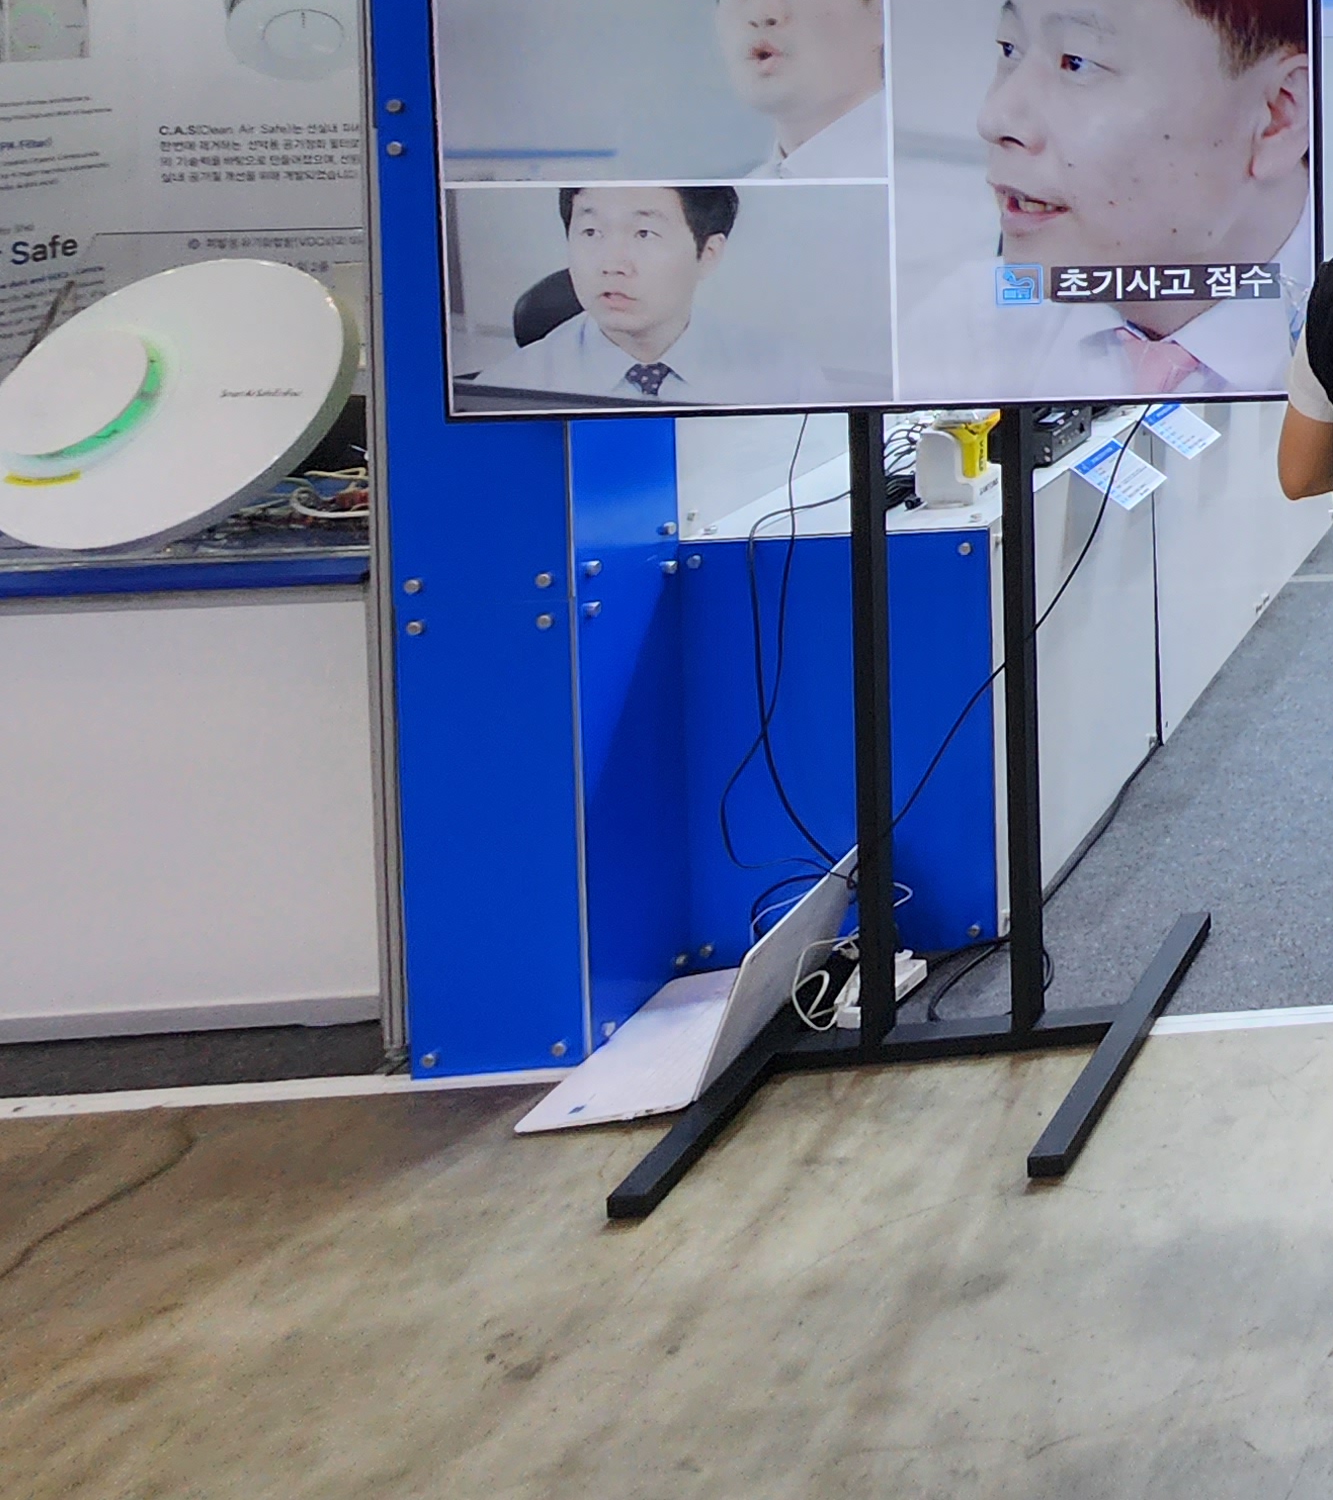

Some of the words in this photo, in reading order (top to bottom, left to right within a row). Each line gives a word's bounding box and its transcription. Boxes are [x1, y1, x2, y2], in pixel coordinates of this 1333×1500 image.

[10, 235, 78, 266] Safe
[1056, 267, 1195, 299] 초기사고
[1205, 265, 1273, 298] 접수
